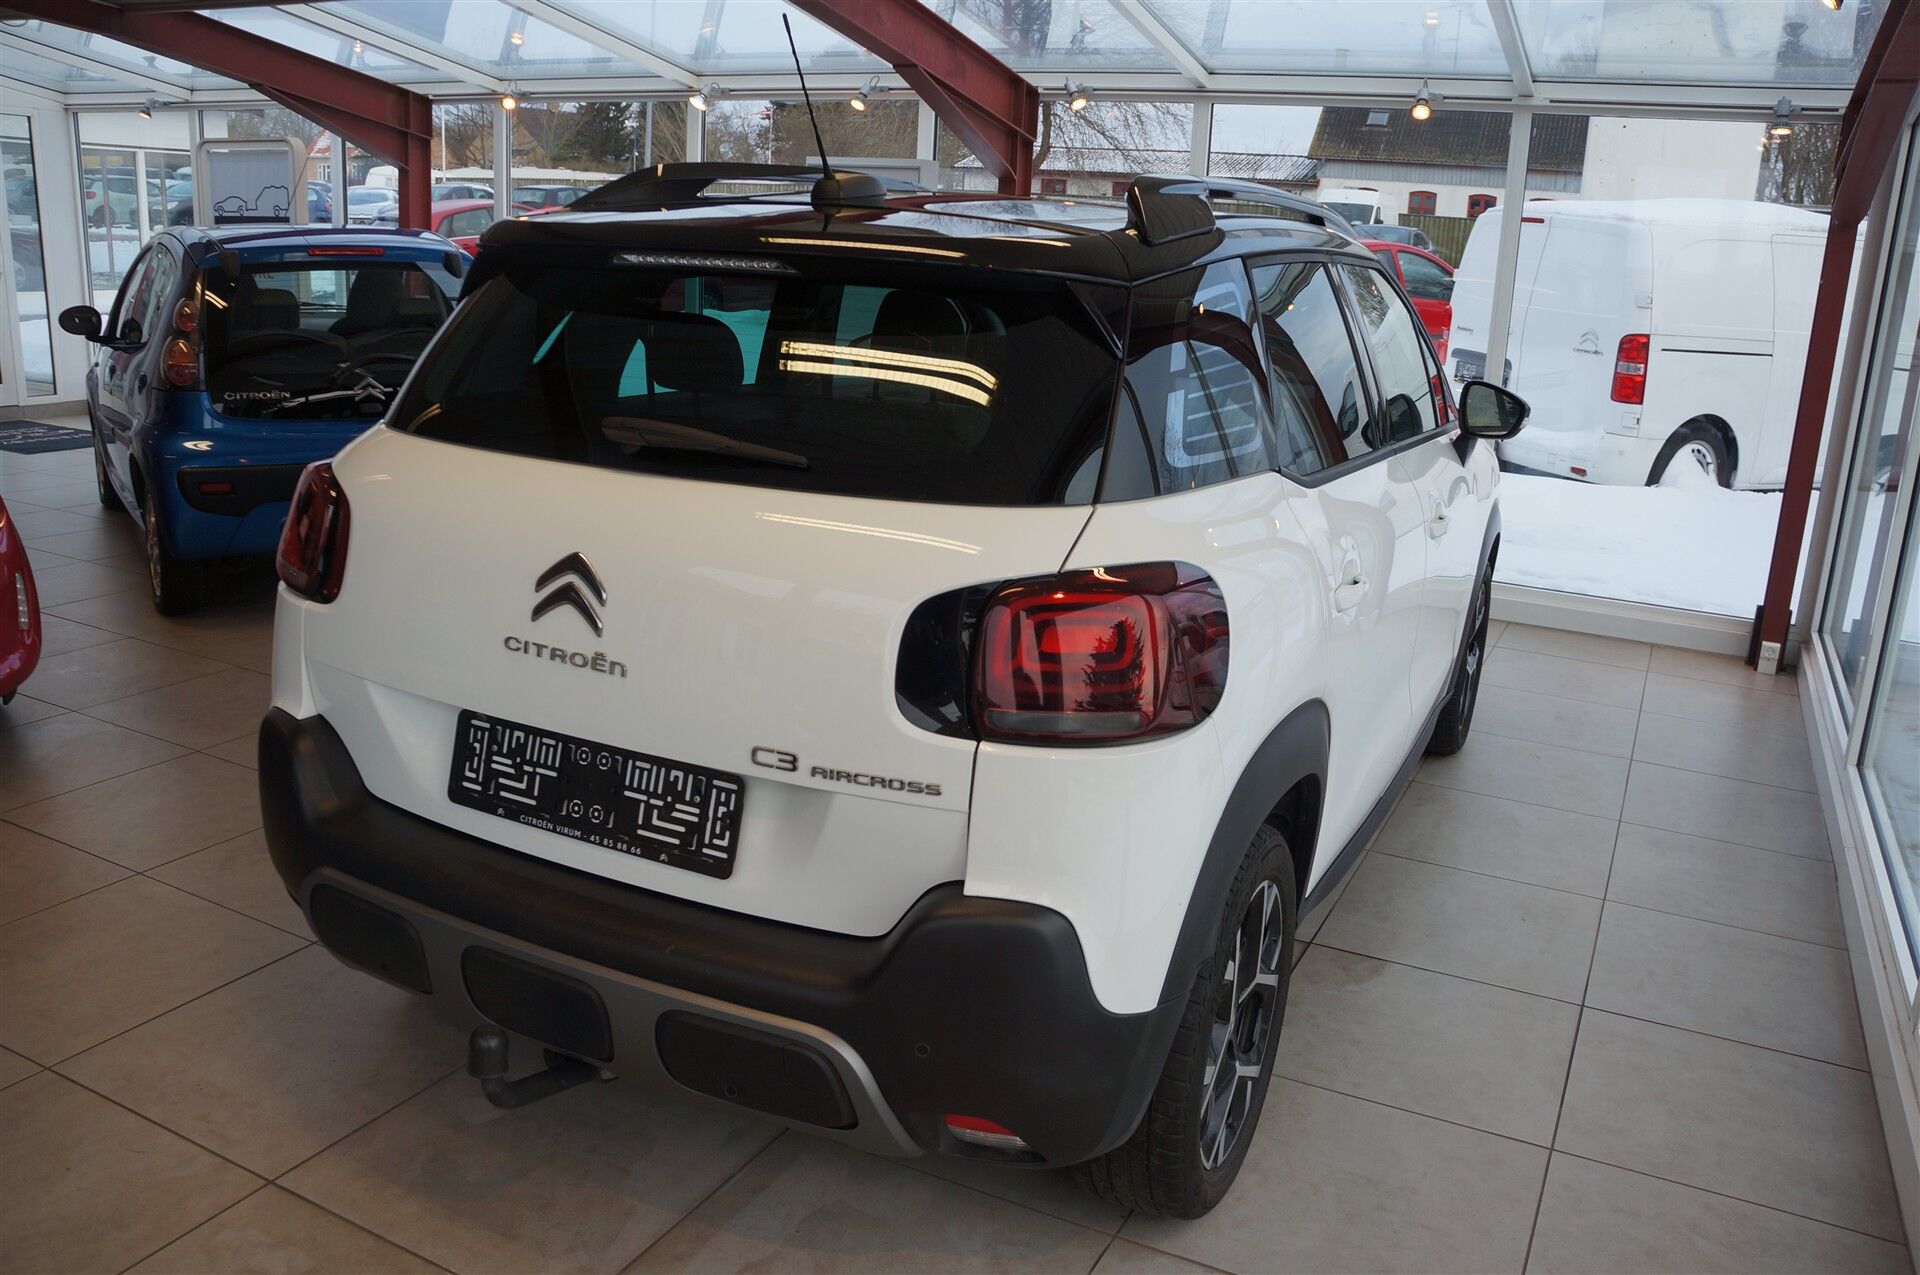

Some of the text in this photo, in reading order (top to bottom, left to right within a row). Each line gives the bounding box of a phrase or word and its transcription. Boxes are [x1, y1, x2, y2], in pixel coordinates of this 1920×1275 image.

[751, 745, 942, 797] C3 AIRCROSS
[520, 814, 554, 830] CITROËN
[556, 824, 582, 838] VIRUM
[589, 834, 601, 844] 45
[603, 838, 614, 847] 85
[616, 842, 628, 851] 88
[630, 845, 642, 855] 66
